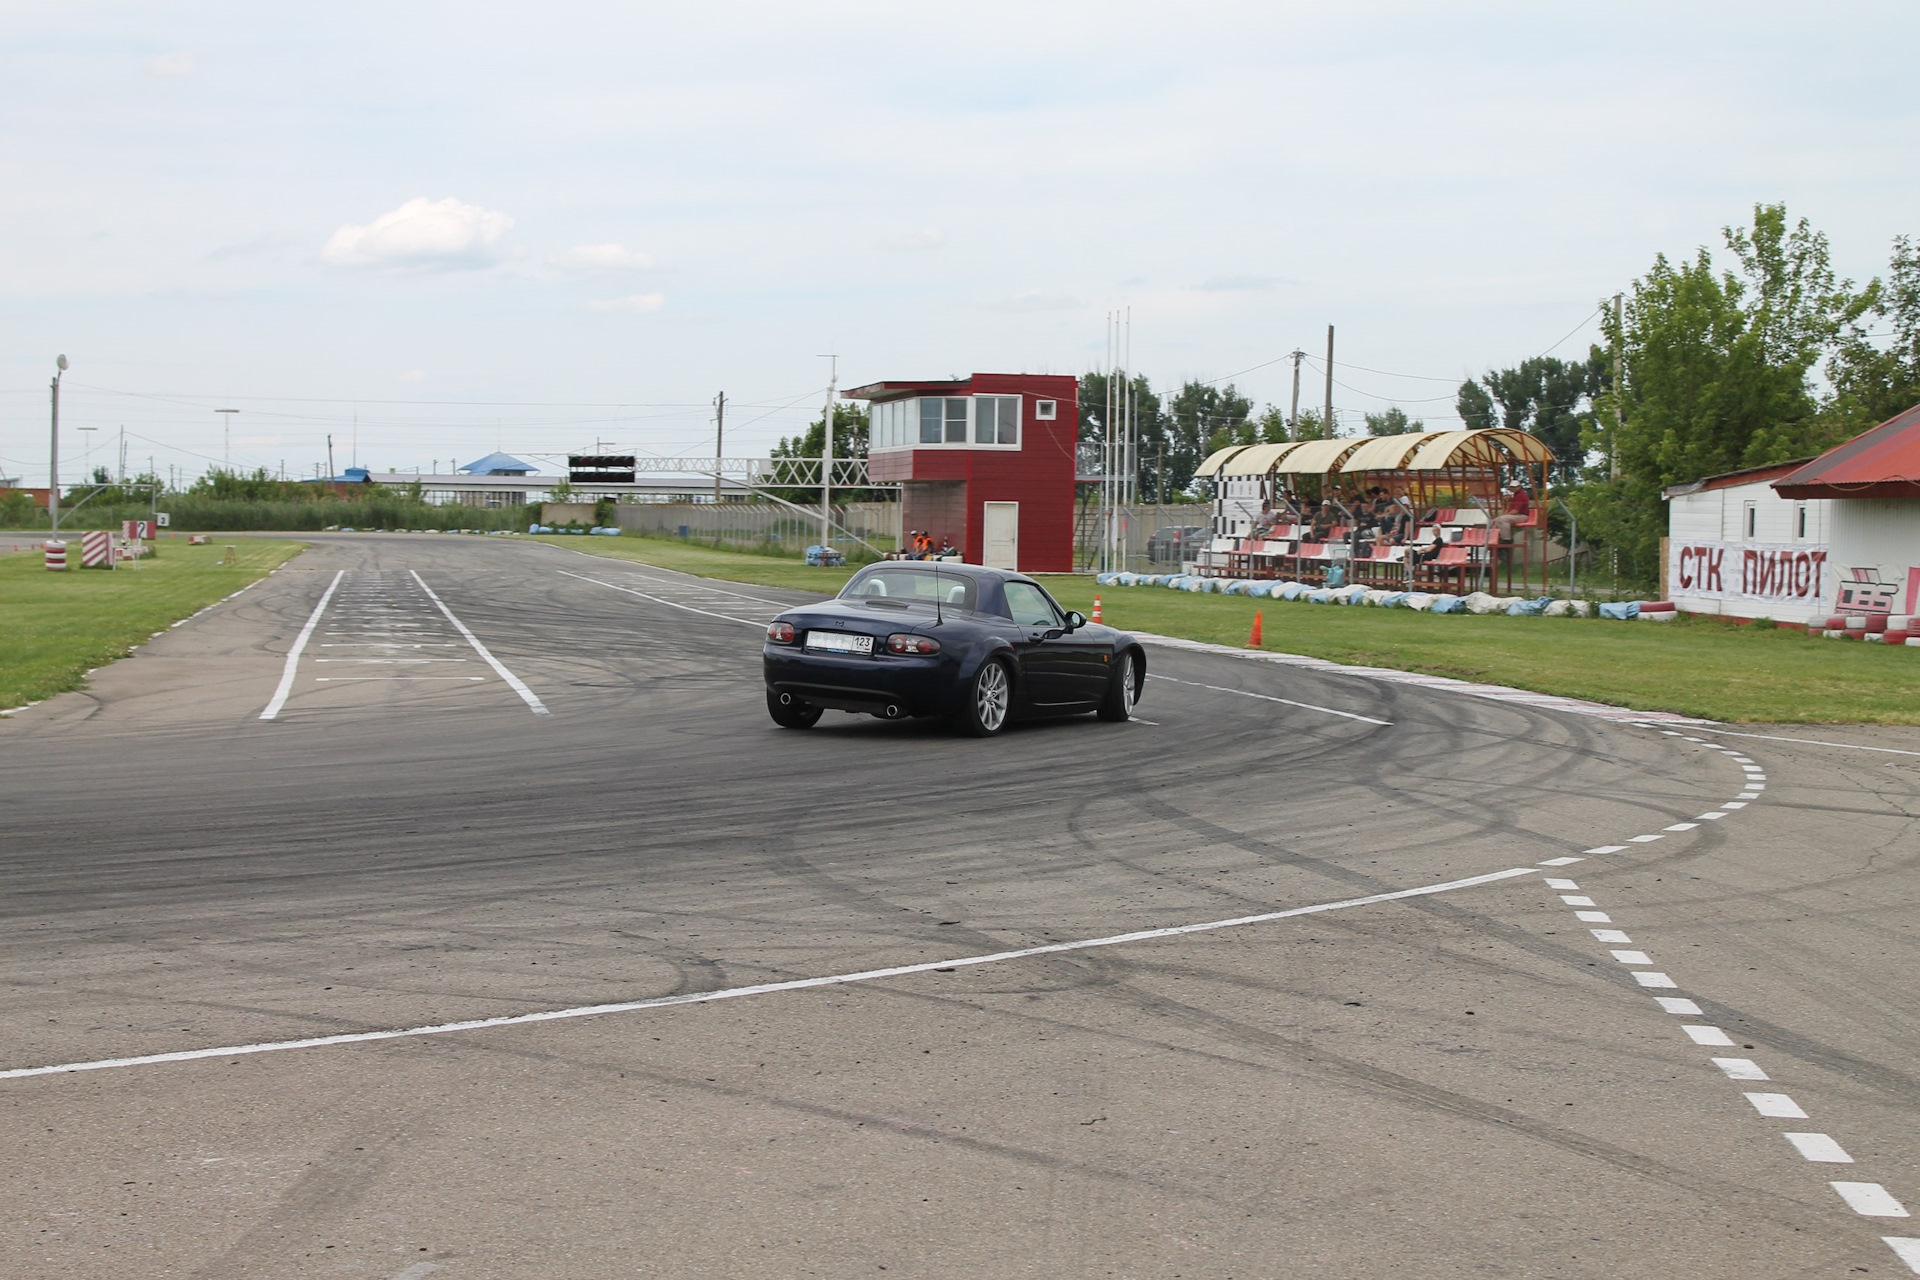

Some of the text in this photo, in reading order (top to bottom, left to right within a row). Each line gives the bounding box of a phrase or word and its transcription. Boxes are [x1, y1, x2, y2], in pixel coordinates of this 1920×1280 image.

[160, 517, 166, 525] 3
[138, 521, 146, 539] 2
[1679, 546, 1827, 598] СТК ПИЛОТ
[854, 637, 871, 647] 123
